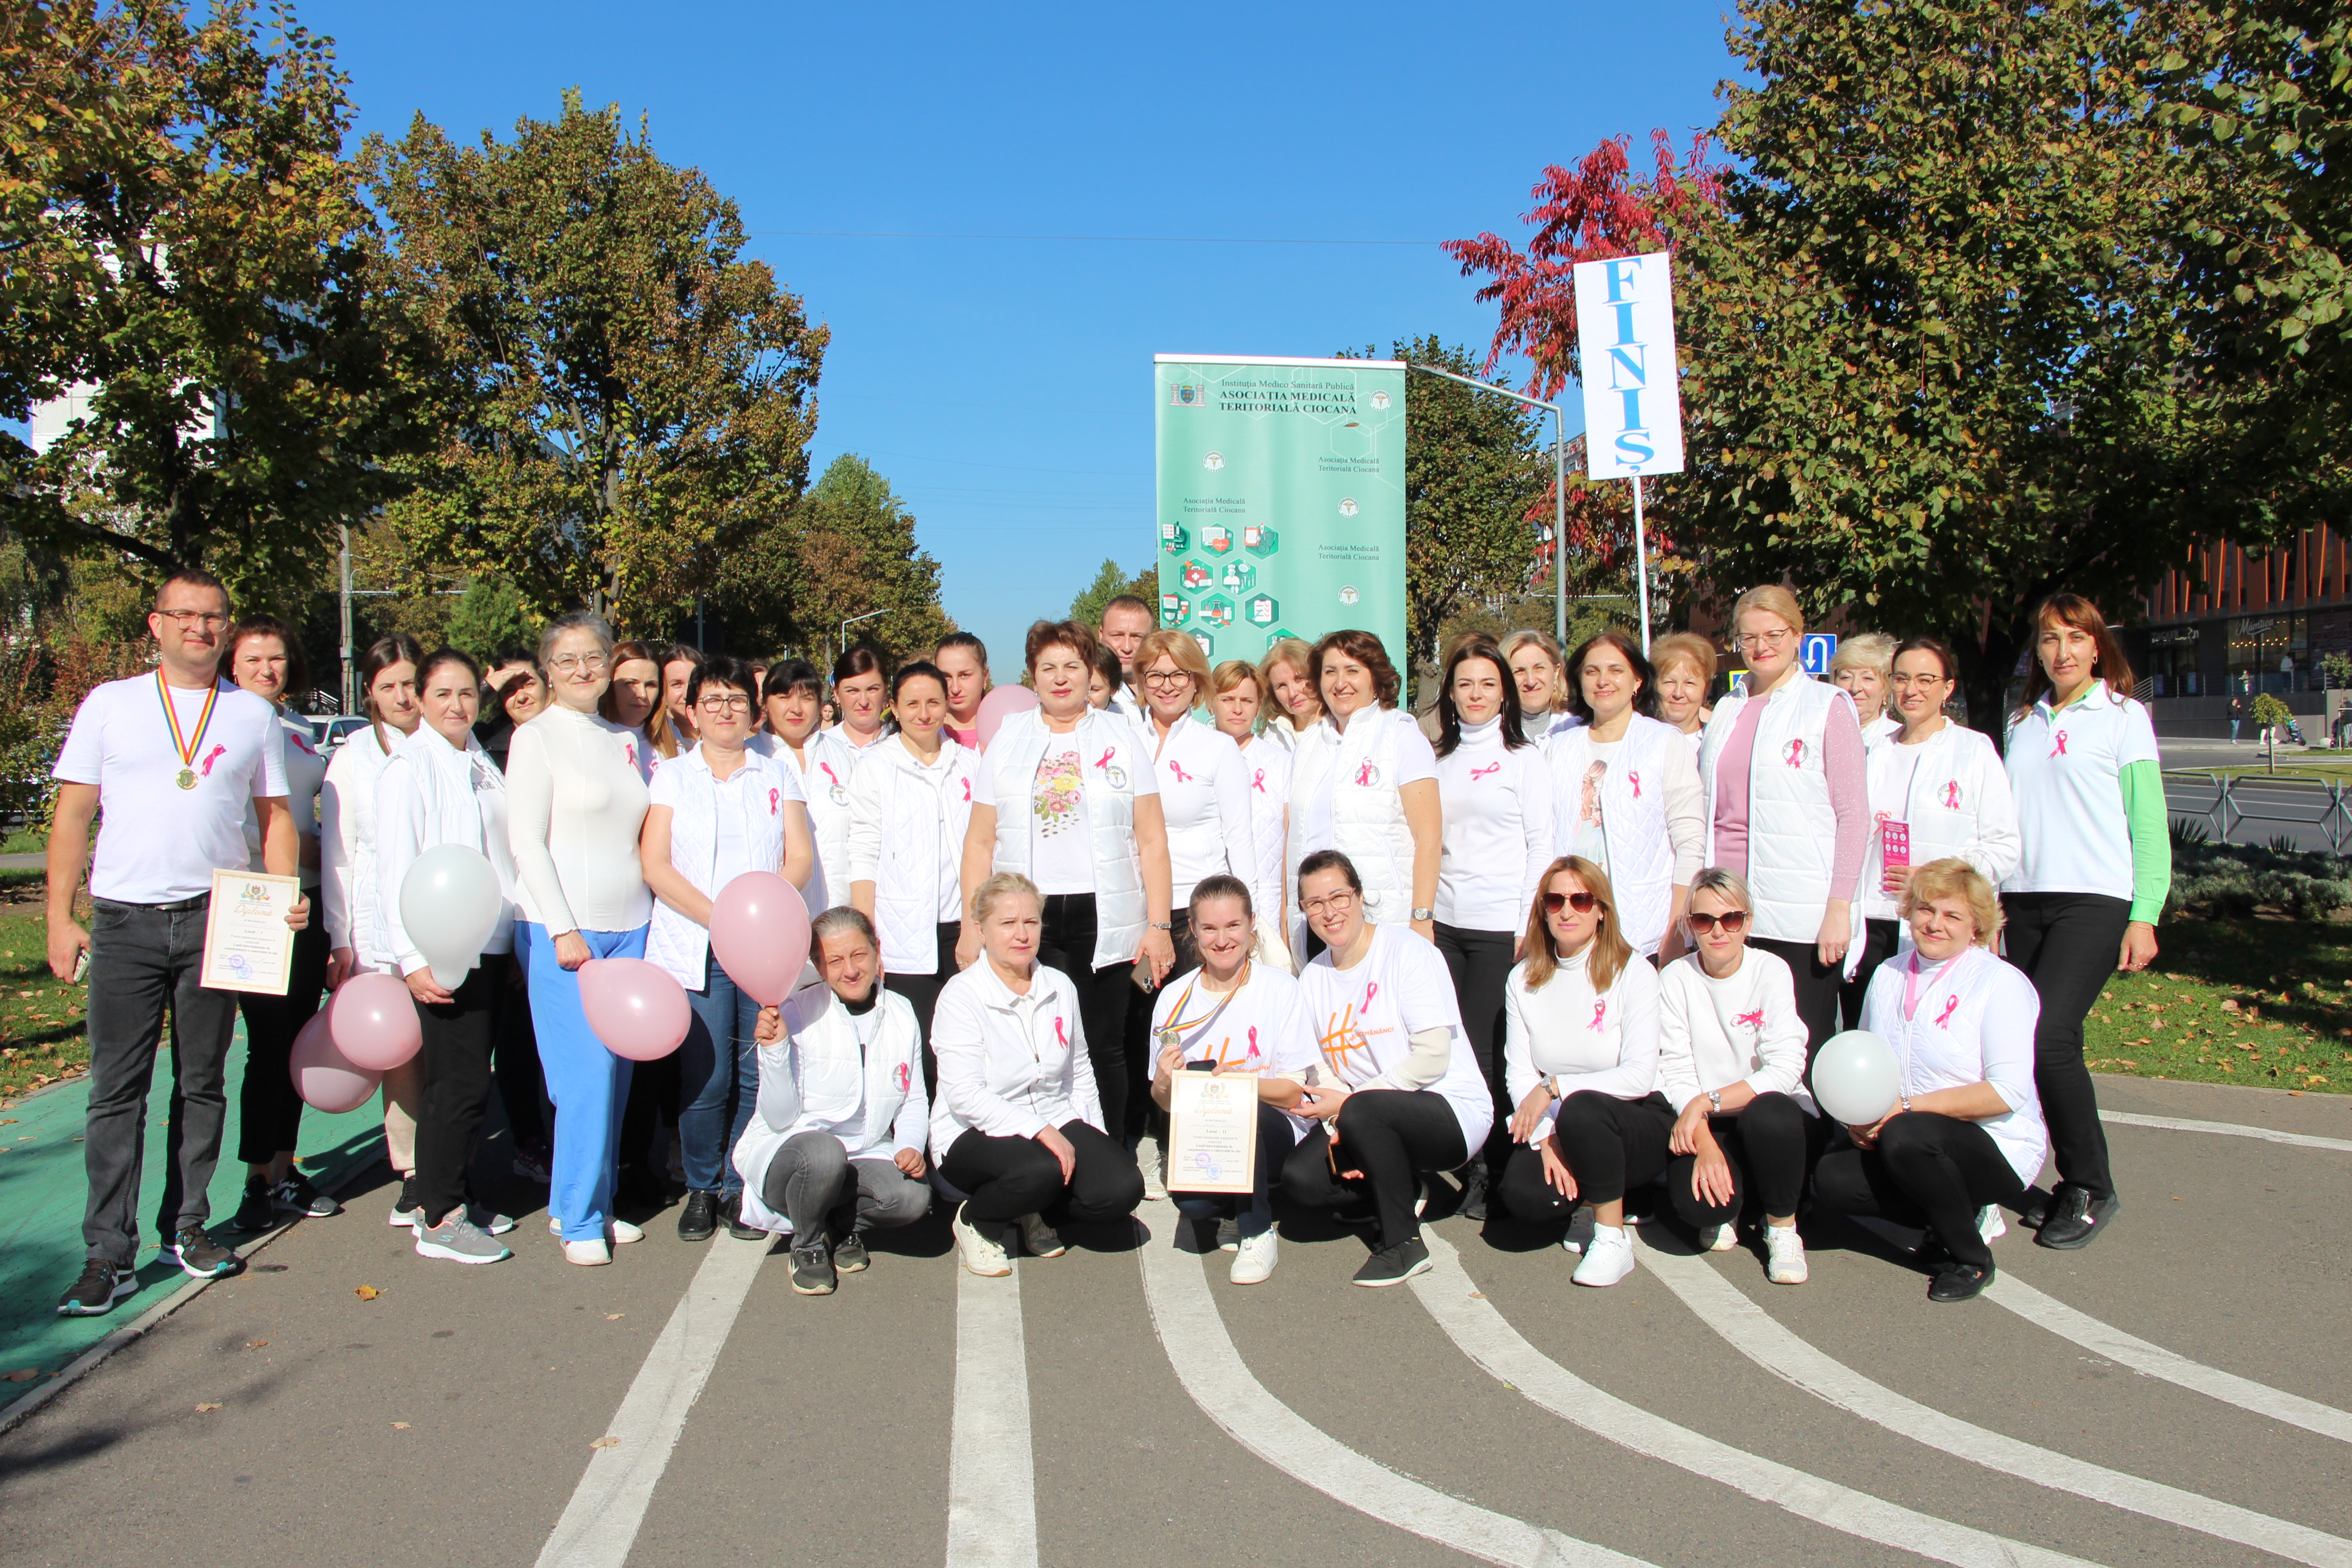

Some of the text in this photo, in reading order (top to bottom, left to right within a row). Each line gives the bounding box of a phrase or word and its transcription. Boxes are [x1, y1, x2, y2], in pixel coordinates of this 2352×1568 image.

[1259, 380, 1289, 388] Medico
[1291, 381, 1323, 389] Sanitară
[1325, 382, 1354, 390] Publică
[1290, 392, 1356, 402] MEDICALĂ
[1219, 402, 1357, 414] TERITORIALĂ CIOCANA
[234, 905, 273, 917] Diplomă
[1194, 1104, 1233, 1117] Diplomă
